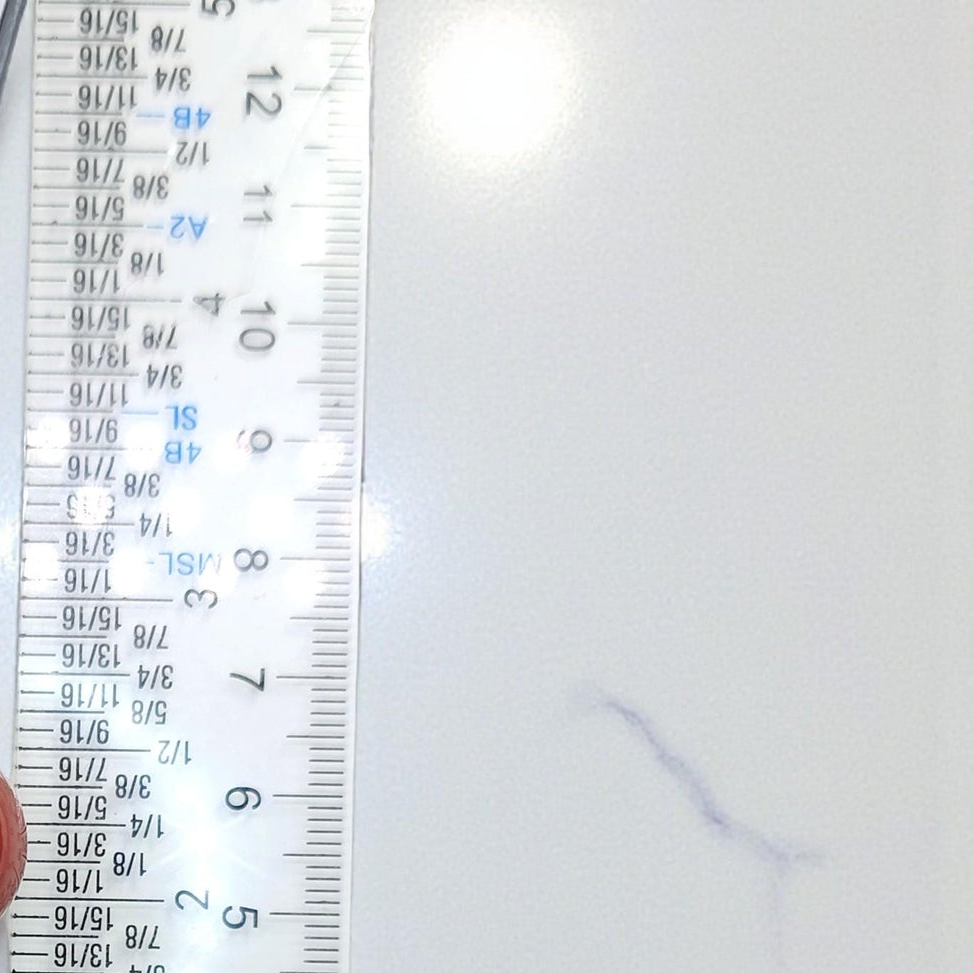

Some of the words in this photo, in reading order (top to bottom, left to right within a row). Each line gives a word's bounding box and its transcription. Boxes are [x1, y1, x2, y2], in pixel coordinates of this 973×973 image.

[80, 10, 138, 33] 15/16
[151, 26, 186, 52] 7/8
[79, 46, 137, 71] 13/16
[155, 68, 191, 91] 3/4
[245, 66, 283, 116] 12
[78, 85, 137, 110] 11/16
[173, 106, 211, 129] 4B
[77, 120, 127, 145] 9/16
[177, 143, 209, 166] 1/2
[76, 158, 124, 182] 7/16
[133, 176, 169, 200] 3/8
[76, 196, 124, 221] 5/16
[170, 217, 208, 239] A2
[74, 233, 123, 257] 3/16
[131, 252, 163, 276] 1/8
[73, 270, 120, 293] 1/16
[71, 306, 130, 330] 15/16
[239, 302, 276, 351] 10
[143, 325, 176, 349] 7/8
[71, 344, 129, 367] 13/16
[147, 365, 182, 388] 3/4
[70, 383, 128, 407] 11/16
[166, 405, 197, 430] SL
[69, 419, 118, 443] 9/16
[164, 441, 202, 464] 4B
[68, 456, 116, 480] 7/16
[125, 473, 160, 498] 3/8
[139, 514, 172, 537] 1/4
[65, 532, 114, 556] 3/16
[234, 548, 268, 571] 8
[65, 568, 110, 593] 1/16
[184, 589, 217, 609] 3
[63, 606, 121, 631] 15/16
[133, 625, 168, 649] 7/8
[62, 644, 120, 668] 13/16
[138, 665, 173, 689] 3/4
[230, 668, 265, 691] 7
[61, 683, 119, 708] 11/16
[132, 700, 167, 725] 5/8
[60, 720, 109, 744] 9/16
[158, 740, 192, 765] 1/2
[59, 757, 107, 782] 7/16
[115, 775, 151, 799] 3/8
[225, 786, 261, 811] 6
[58, 796, 107, 820] 5/16
[131, 814, 164, 838] 1/4
[57, 833, 106, 857] 3/16
[113, 853, 146, 876] 1/8
[56, 869, 103, 894] 1/16
[175, 890, 209, 910] 2
[55, 907, 113, 931] 15/16
[222, 906, 258, 929] 5
[126, 925, 160, 949] 7/8
[54, 944, 112, 968] 13/16
